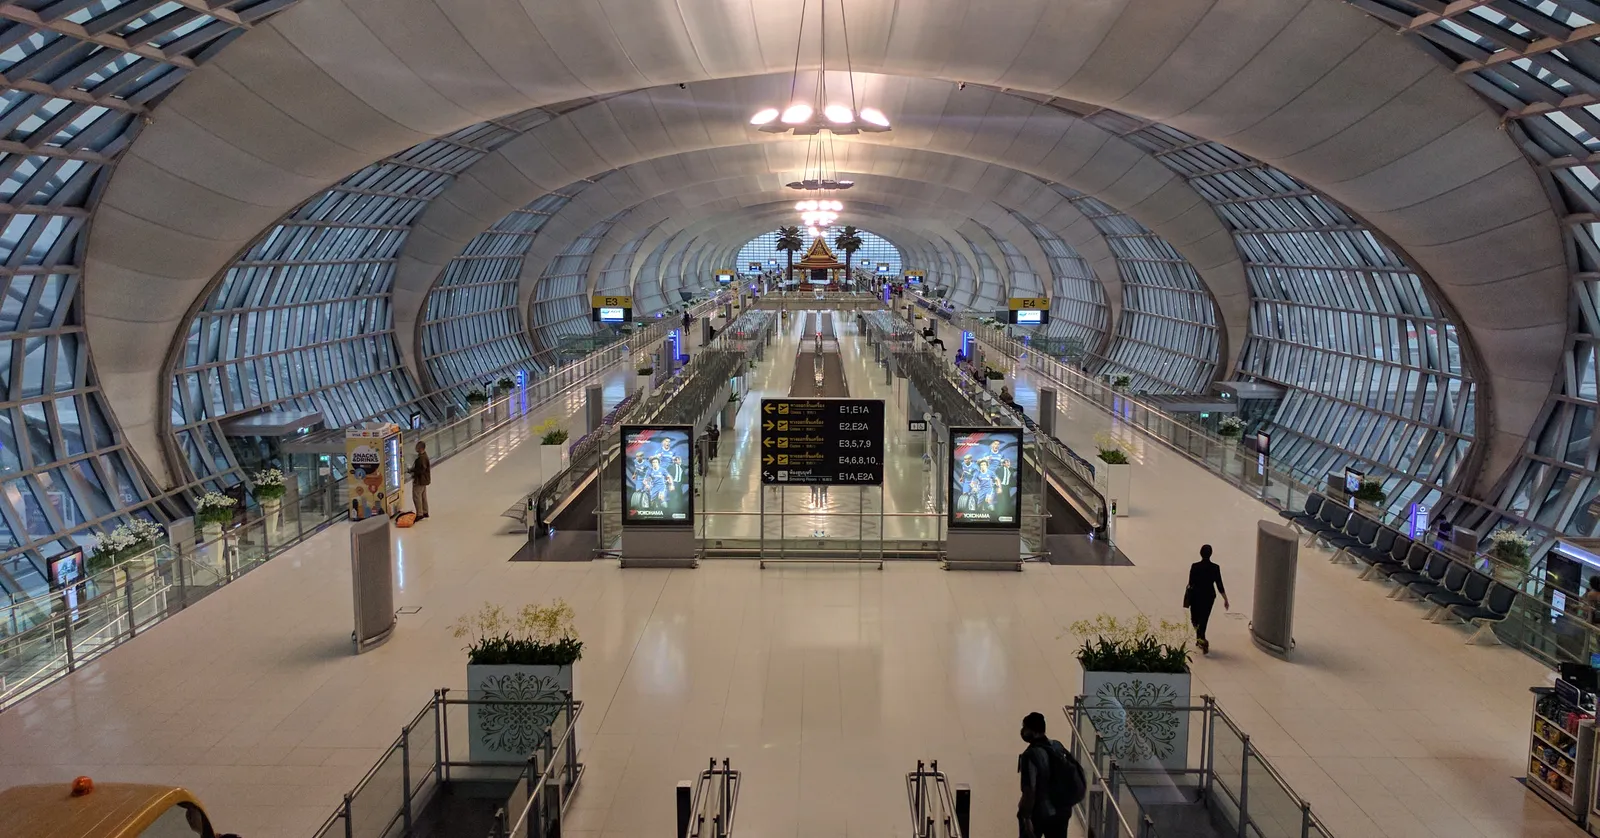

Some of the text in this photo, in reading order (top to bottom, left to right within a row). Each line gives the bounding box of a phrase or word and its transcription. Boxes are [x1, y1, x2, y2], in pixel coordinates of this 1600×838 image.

[605, 297, 618, 306] E3
[1023, 300, 1036, 308] E4
[840, 405, 869, 414] E1,E1A
[839, 422, 869, 431] E2,E2A
[839, 440, 871, 448] E3,5,7,9
[838, 472, 874, 481] E1A,E2A
